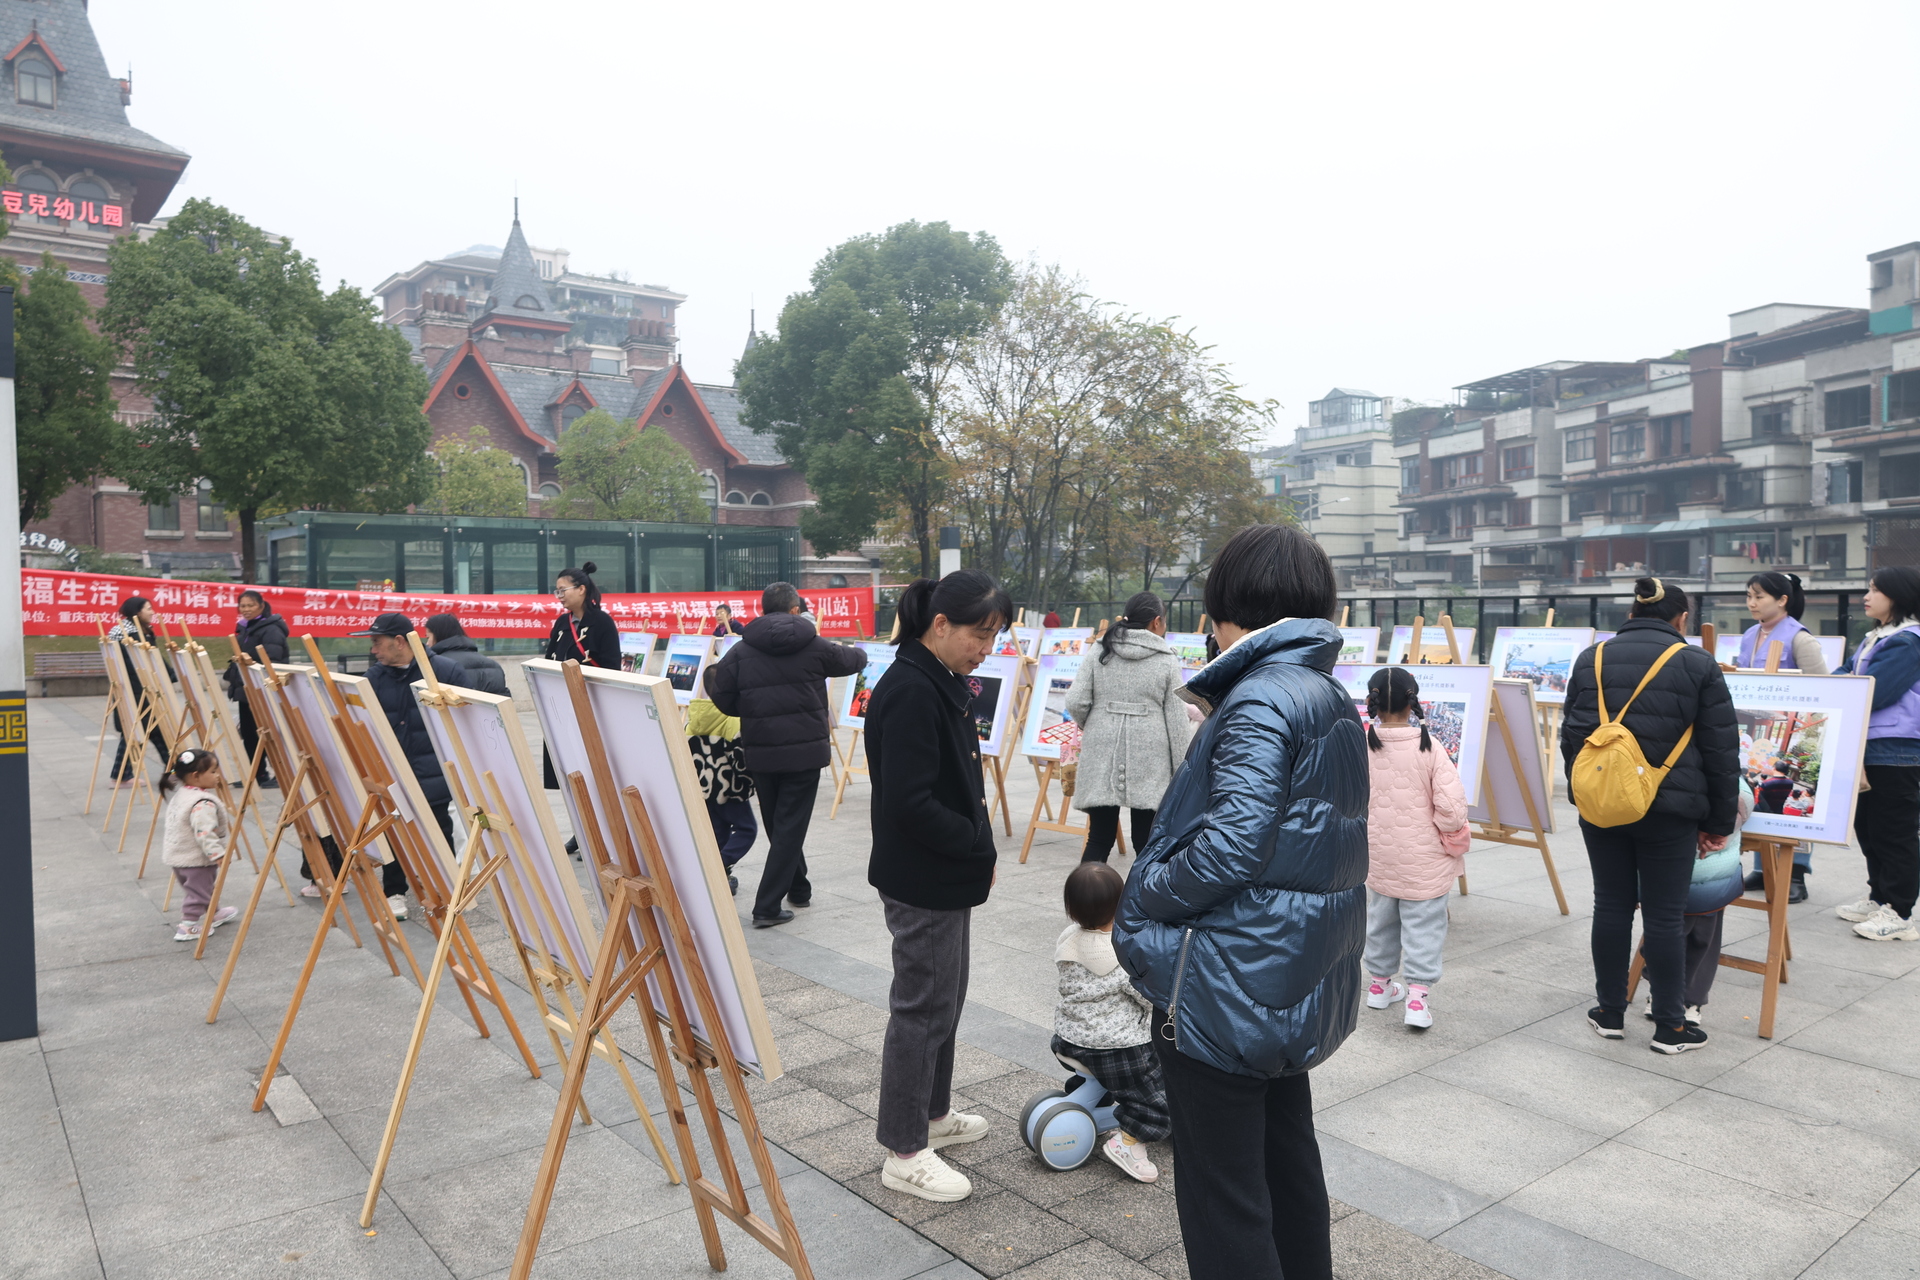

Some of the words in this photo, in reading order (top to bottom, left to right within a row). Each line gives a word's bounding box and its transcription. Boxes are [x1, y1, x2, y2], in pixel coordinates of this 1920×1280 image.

[2, 191, 123, 227] 豆兒幼儿园
[1731, 693, 1820, 703] 艺术节-社区生活手机摄影展
